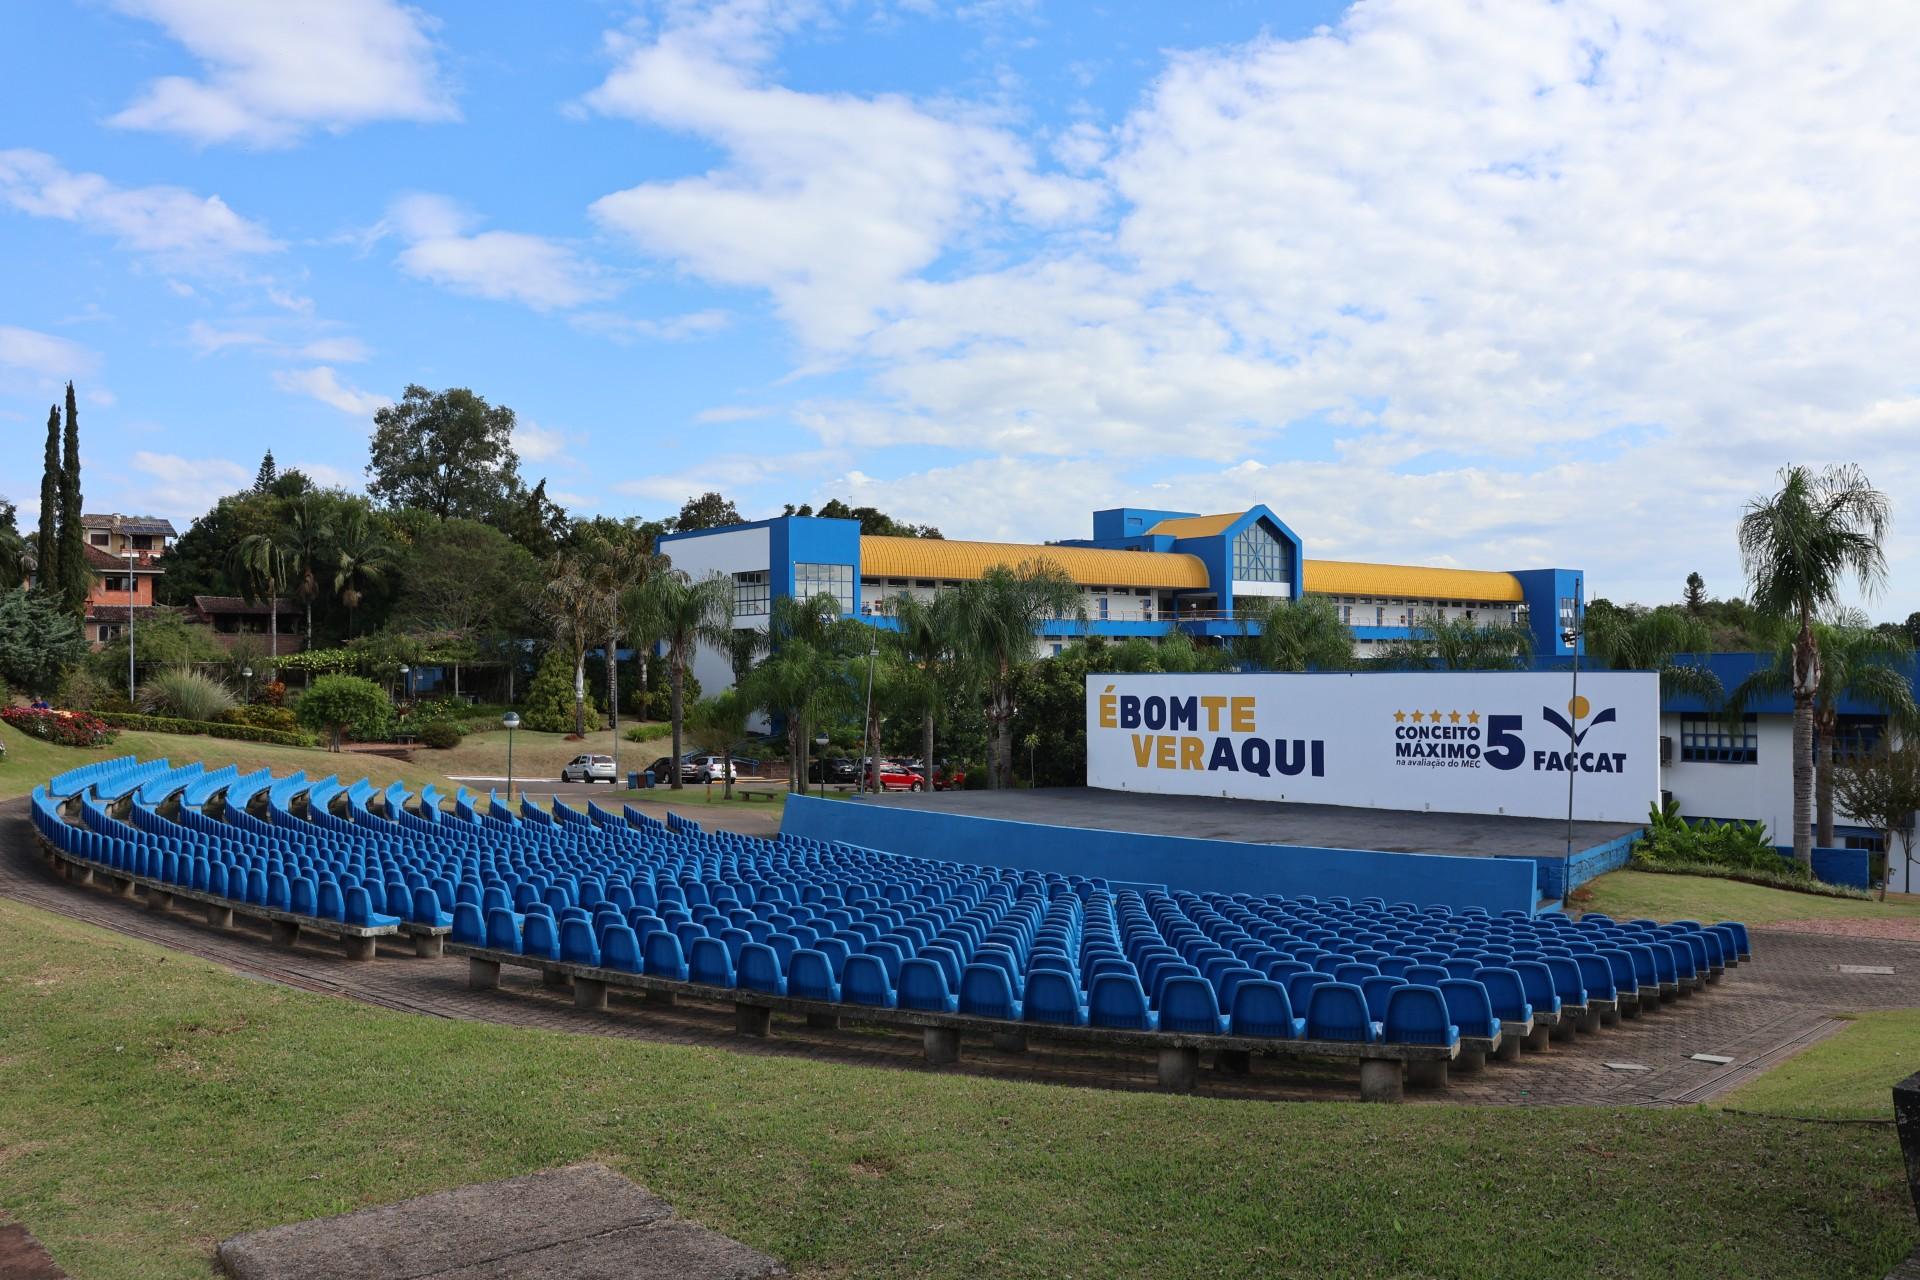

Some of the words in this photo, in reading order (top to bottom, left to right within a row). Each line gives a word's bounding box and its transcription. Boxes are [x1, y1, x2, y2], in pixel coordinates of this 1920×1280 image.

[1099, 685, 1118, 728] É
[1120, 695, 1198, 731] BOM
[1200, 696, 1256, 733] TE
[1395, 725, 1481, 741] CONCEITO
[1483, 715, 1526, 771] 5
[1131, 734, 1205, 770] VER
[1207, 737, 1325, 777] AQUI
[1395, 740, 1481, 760] MÁXIMO
[1407, 758, 1446, 769] avaliação
[1447, 759, 1459, 768] do
[1461, 760, 1481, 769] MEC
[1533, 751, 1627, 774] FACCAT
